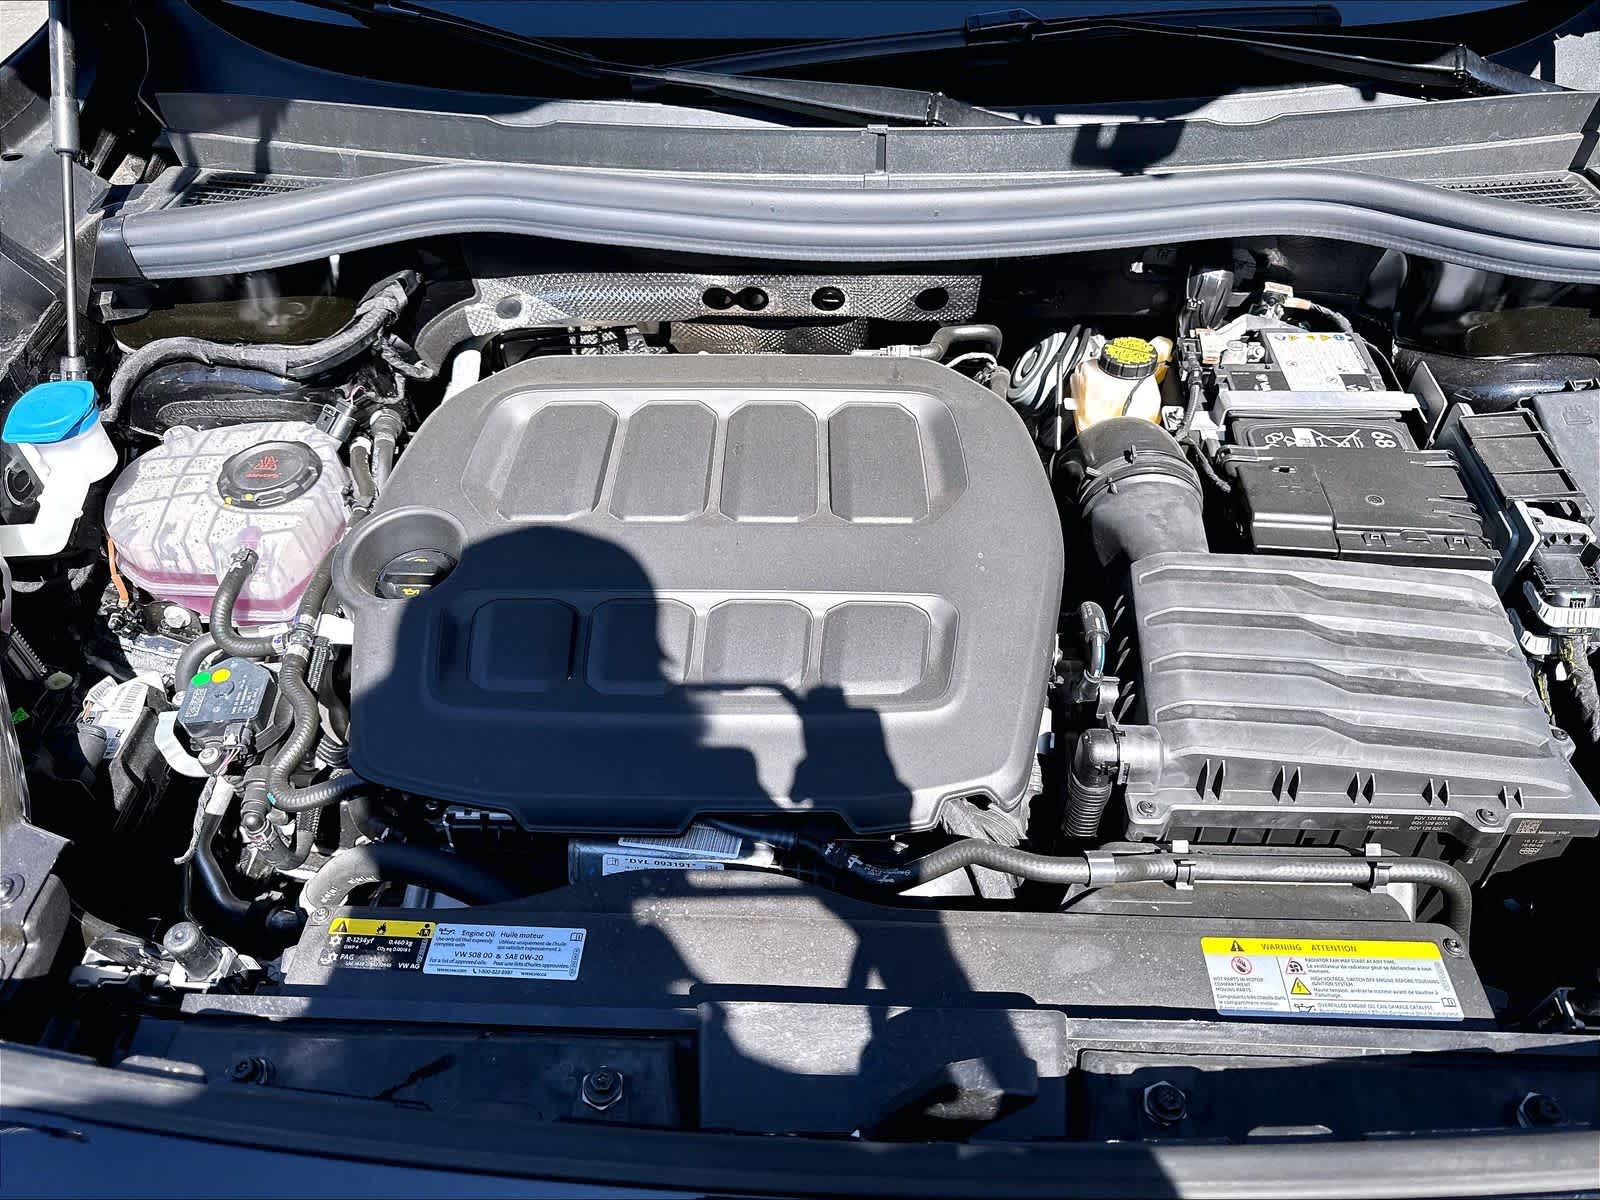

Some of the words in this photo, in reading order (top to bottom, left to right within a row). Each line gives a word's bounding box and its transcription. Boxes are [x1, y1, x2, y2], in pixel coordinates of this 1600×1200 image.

[1260, 943, 1302, 951] WARNING
[1311, 944, 1358, 952] ATTENTION
[468, 951, 481, 959] 508
[505, 952, 518, 960] SAE
[519, 953, 544, 961] 0W-20
